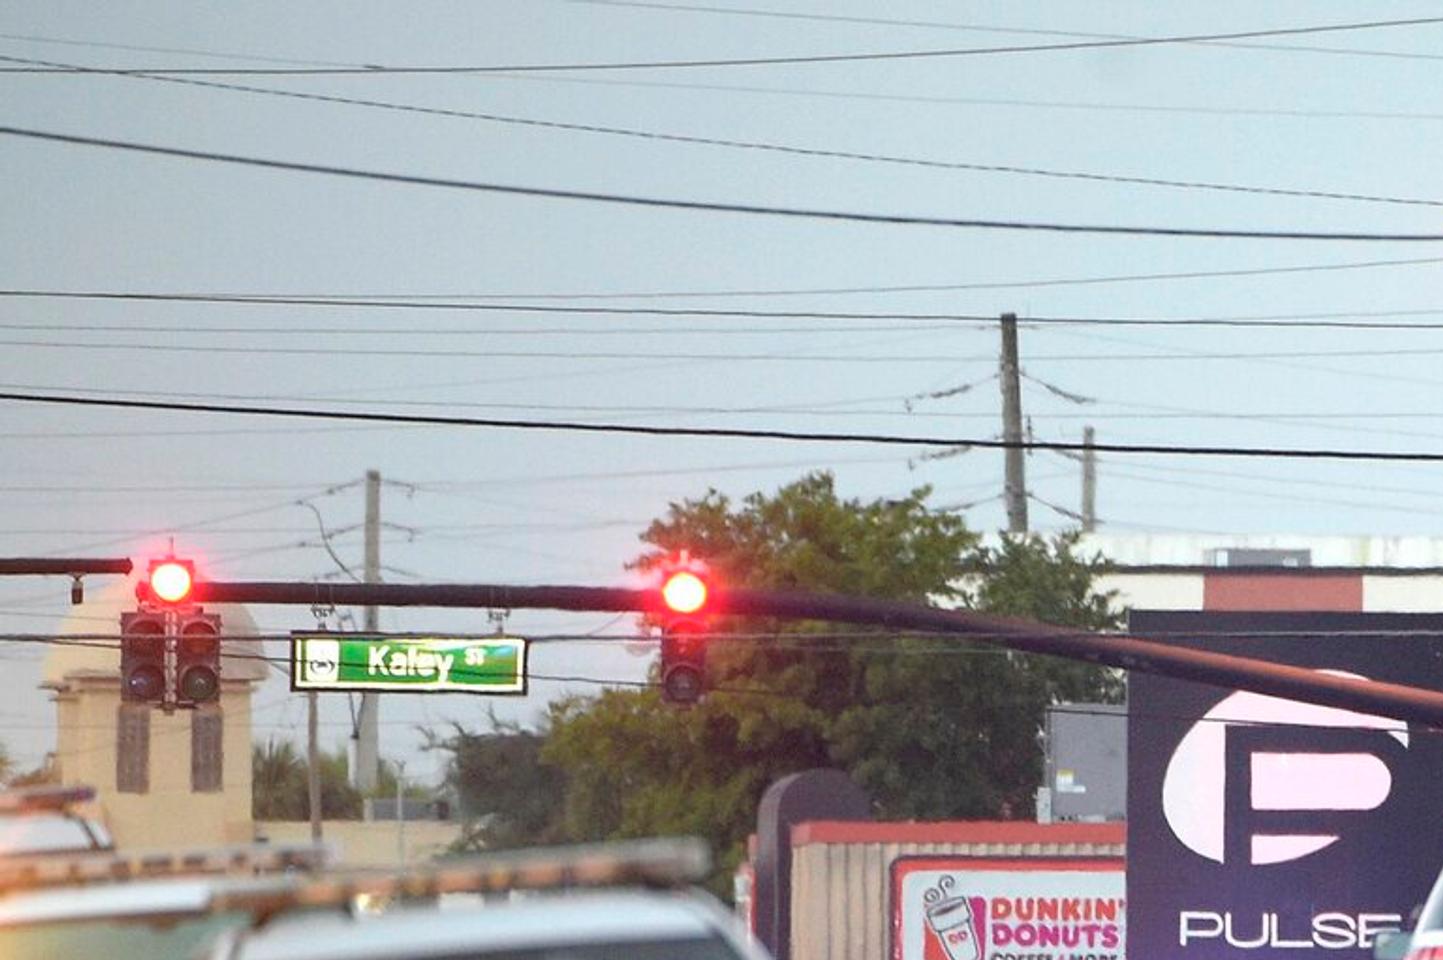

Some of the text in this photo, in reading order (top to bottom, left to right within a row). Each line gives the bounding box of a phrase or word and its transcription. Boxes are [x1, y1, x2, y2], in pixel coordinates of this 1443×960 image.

[367, 645, 487, 683] Kaley ST
[991, 897, 1125, 921] DUNKIN'
[992, 923, 1119, 948] DONUTS
[1180, 911, 1402, 949] PULSE
